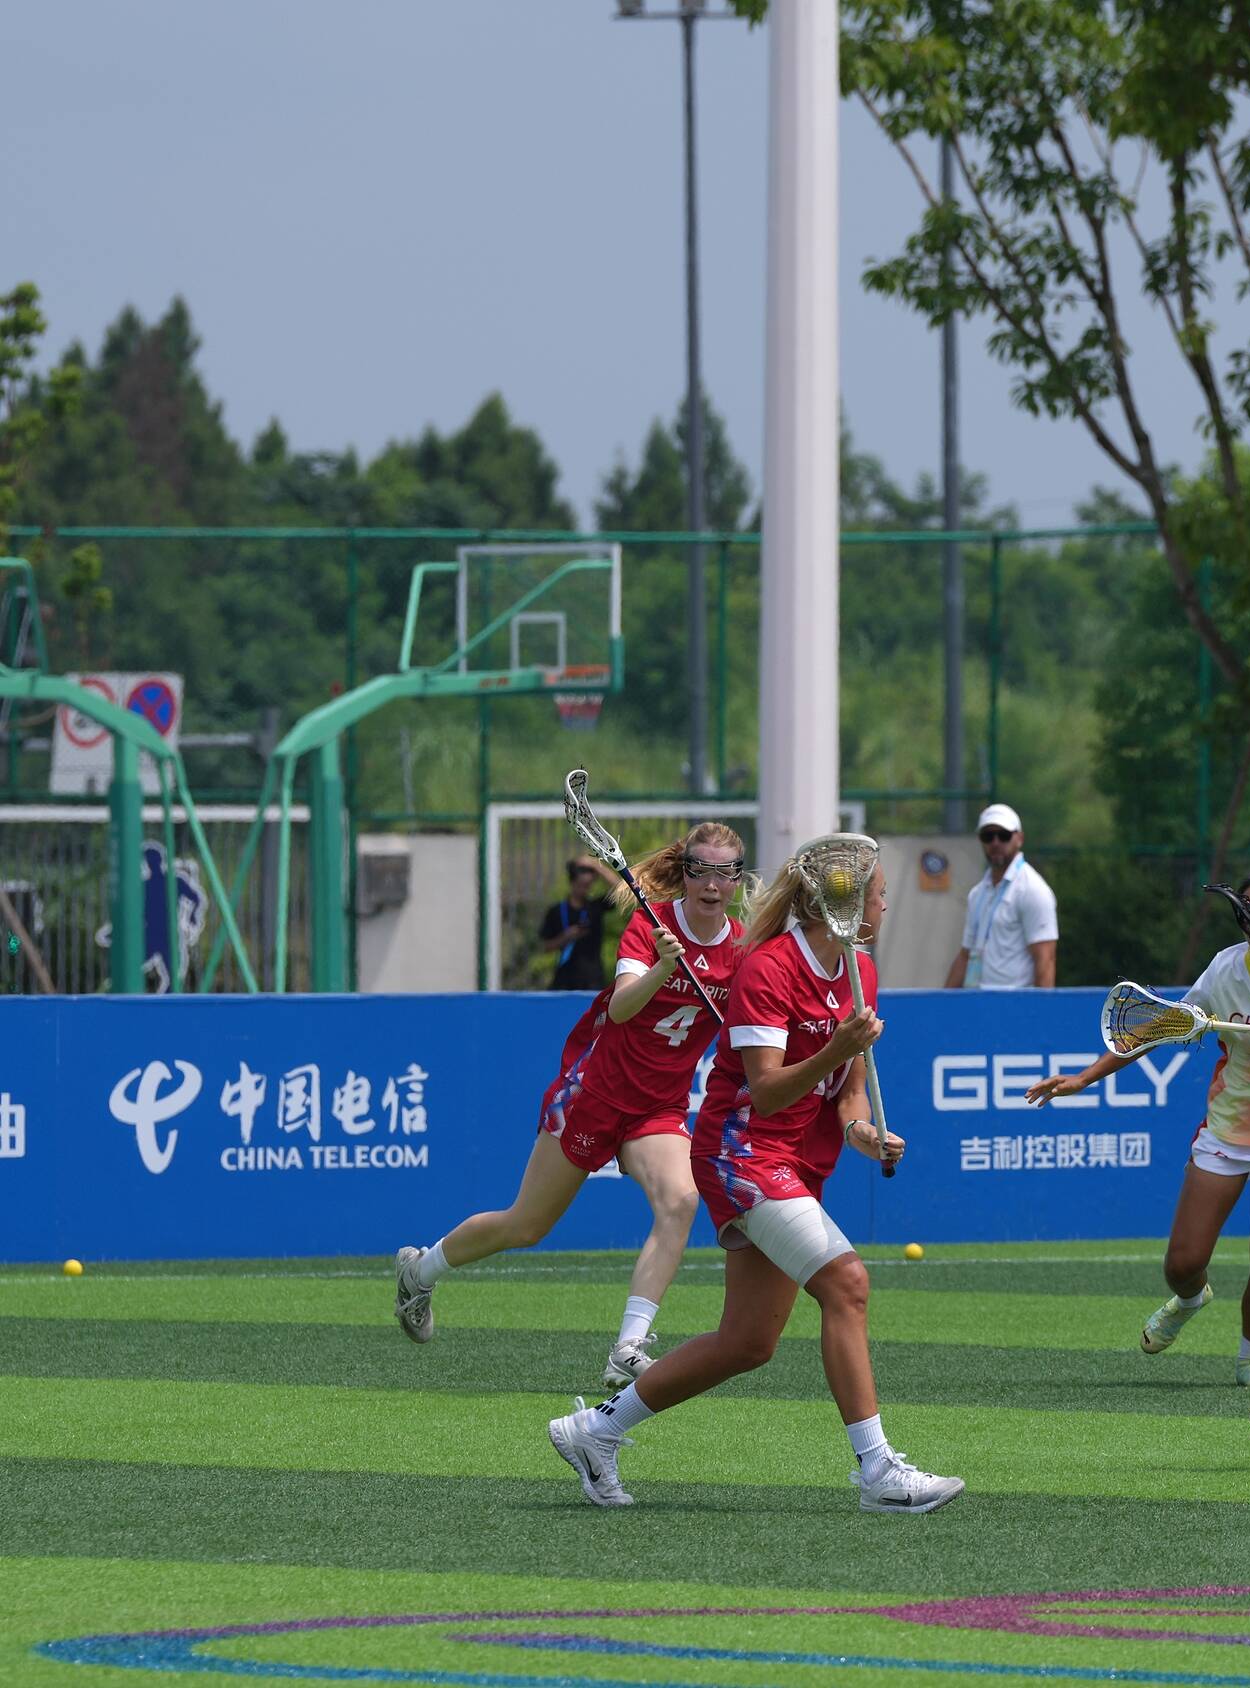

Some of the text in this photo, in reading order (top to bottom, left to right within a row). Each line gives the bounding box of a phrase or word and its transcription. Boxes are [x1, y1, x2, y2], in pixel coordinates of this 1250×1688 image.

[663, 975, 691, 993] EAT
[653, 1005, 703, 1047] 4
[932, 1051, 1190, 1111] GEELY
[219, 1061, 429, 1145] 中国电信
[220, 1145, 429, 1171] CHINA TELECOM
[960, 1132, 1151, 1171] 吉利控股集团
